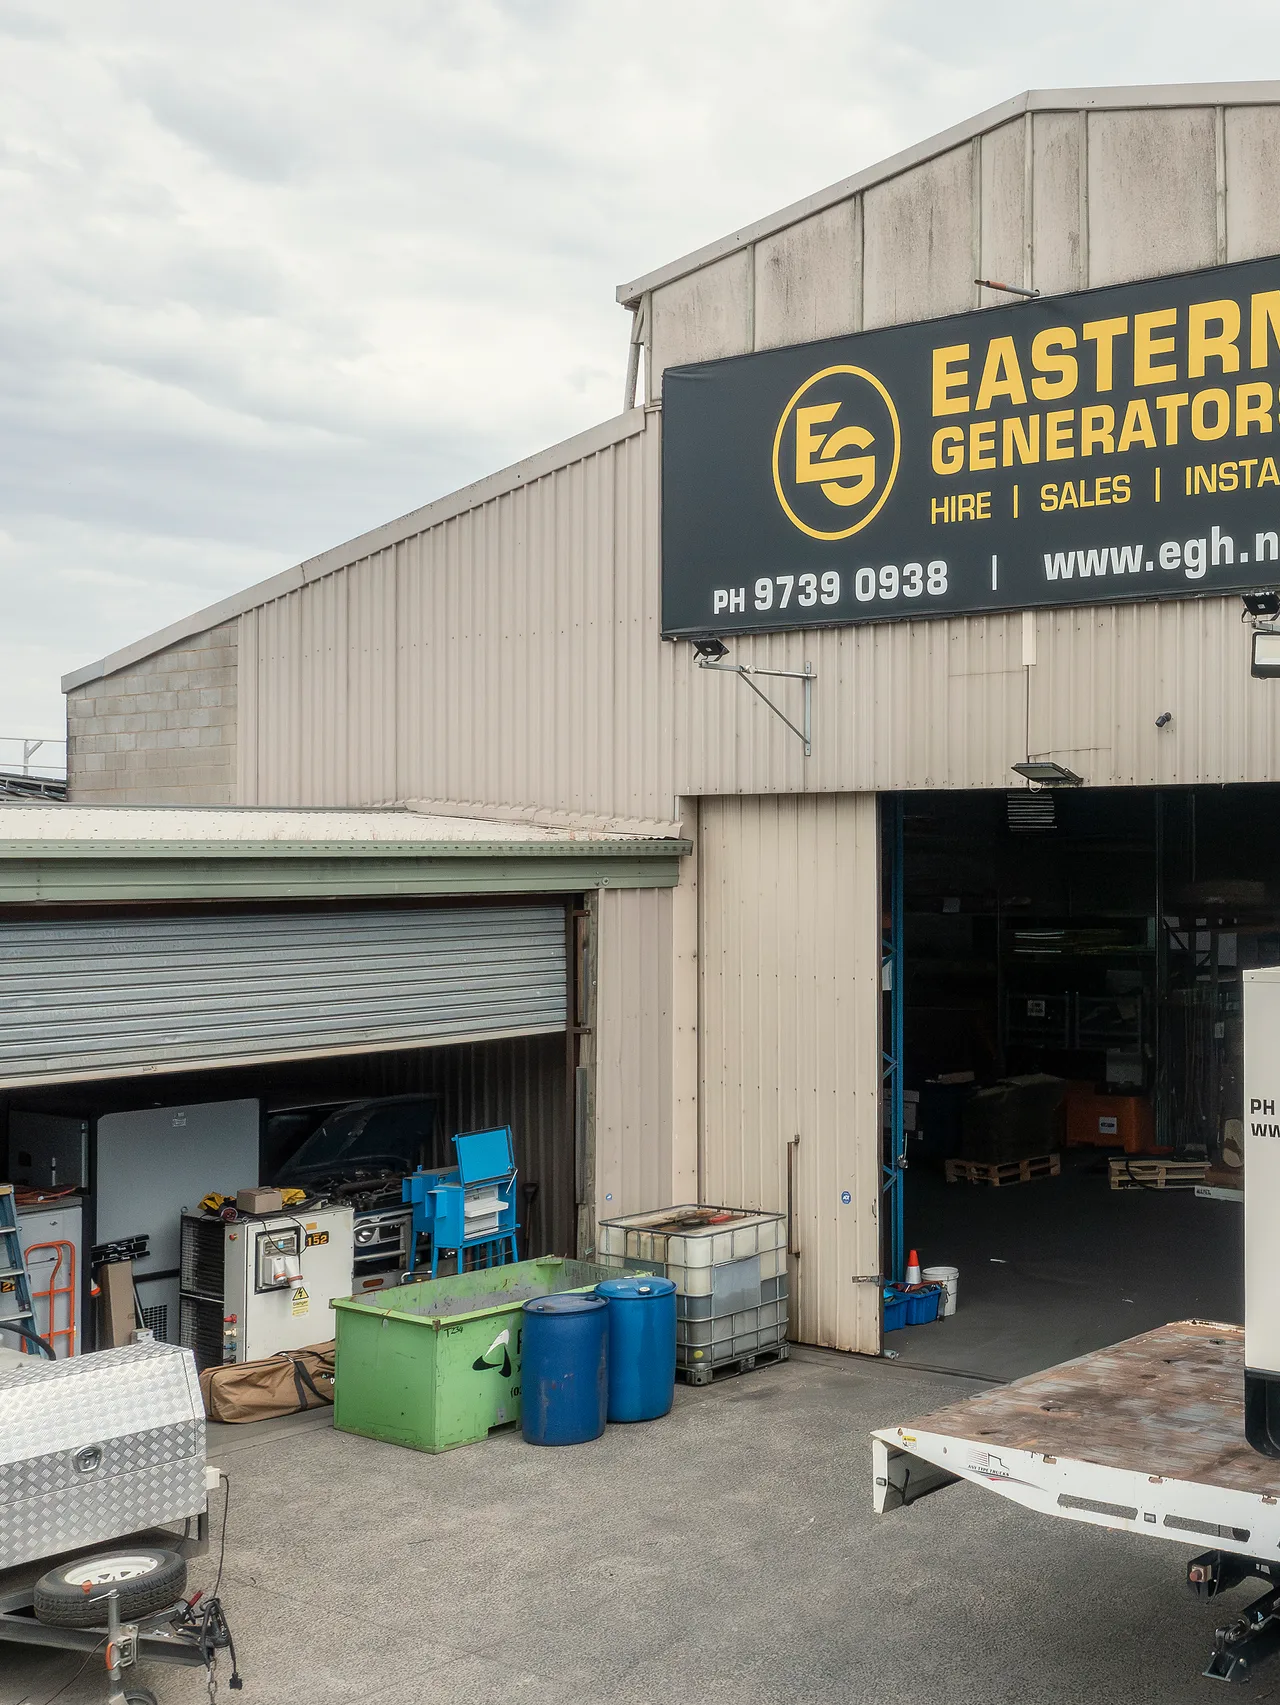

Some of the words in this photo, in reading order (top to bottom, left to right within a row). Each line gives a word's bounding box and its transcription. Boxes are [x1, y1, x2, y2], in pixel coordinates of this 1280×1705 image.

[931, 491, 993, 526] HIRE
[1040, 472, 1132, 513] SALES
[713, 587, 747, 615] PH
[754, 570, 842, 611] 9739
[855, 560, 949, 602] 0938
[1250, 1098, 1275, 1116] PH
[306, 1234, 328, 1246] 152
